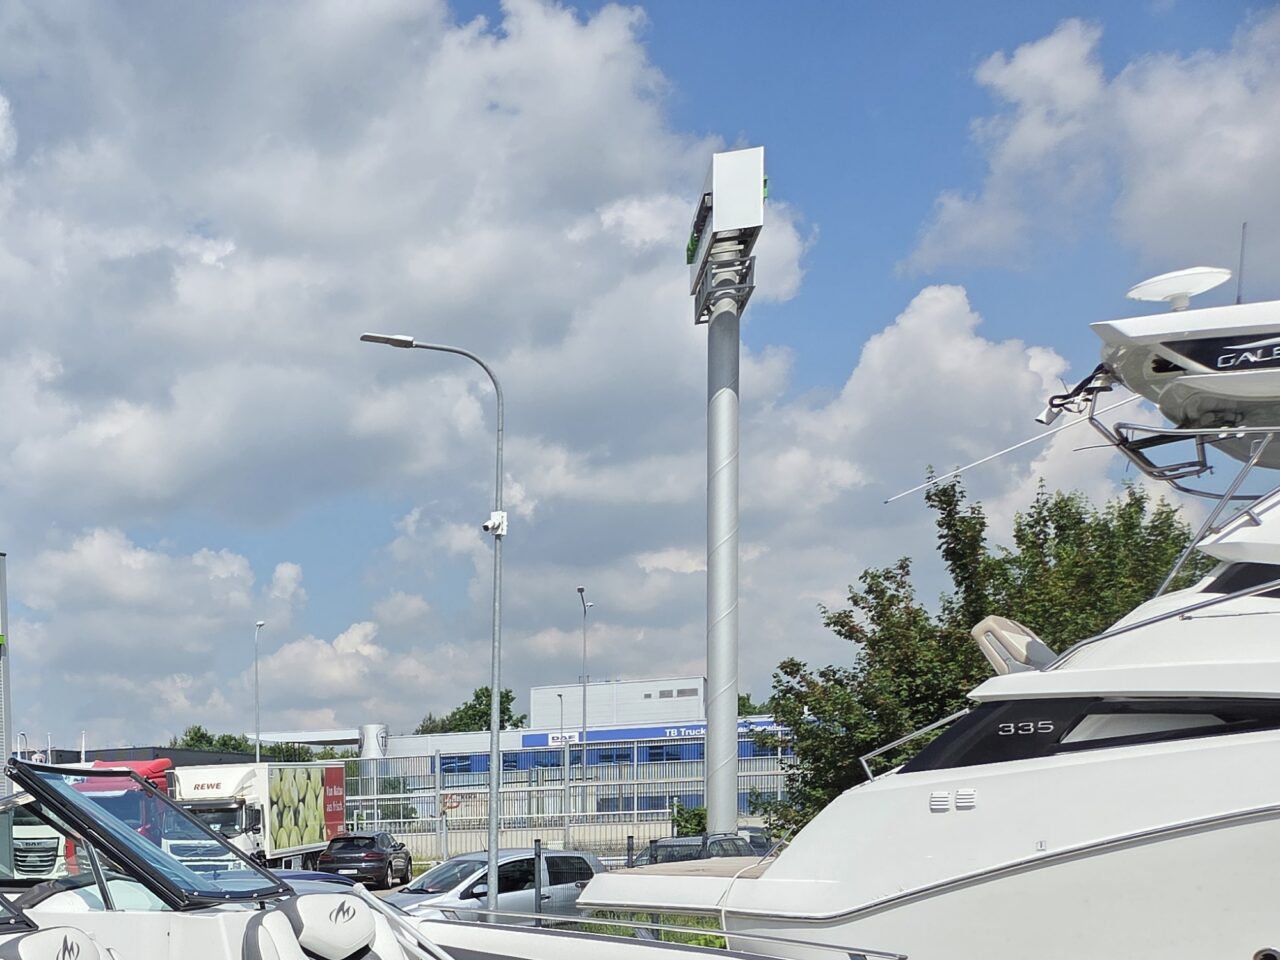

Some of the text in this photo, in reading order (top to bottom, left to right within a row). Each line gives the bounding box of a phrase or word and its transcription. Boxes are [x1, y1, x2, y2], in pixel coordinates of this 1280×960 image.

[665, 728, 678, 737] TB
[681, 727, 706, 736] Truck
[998, 720, 1055, 736] 335
[193, 783, 221, 791] REWE
